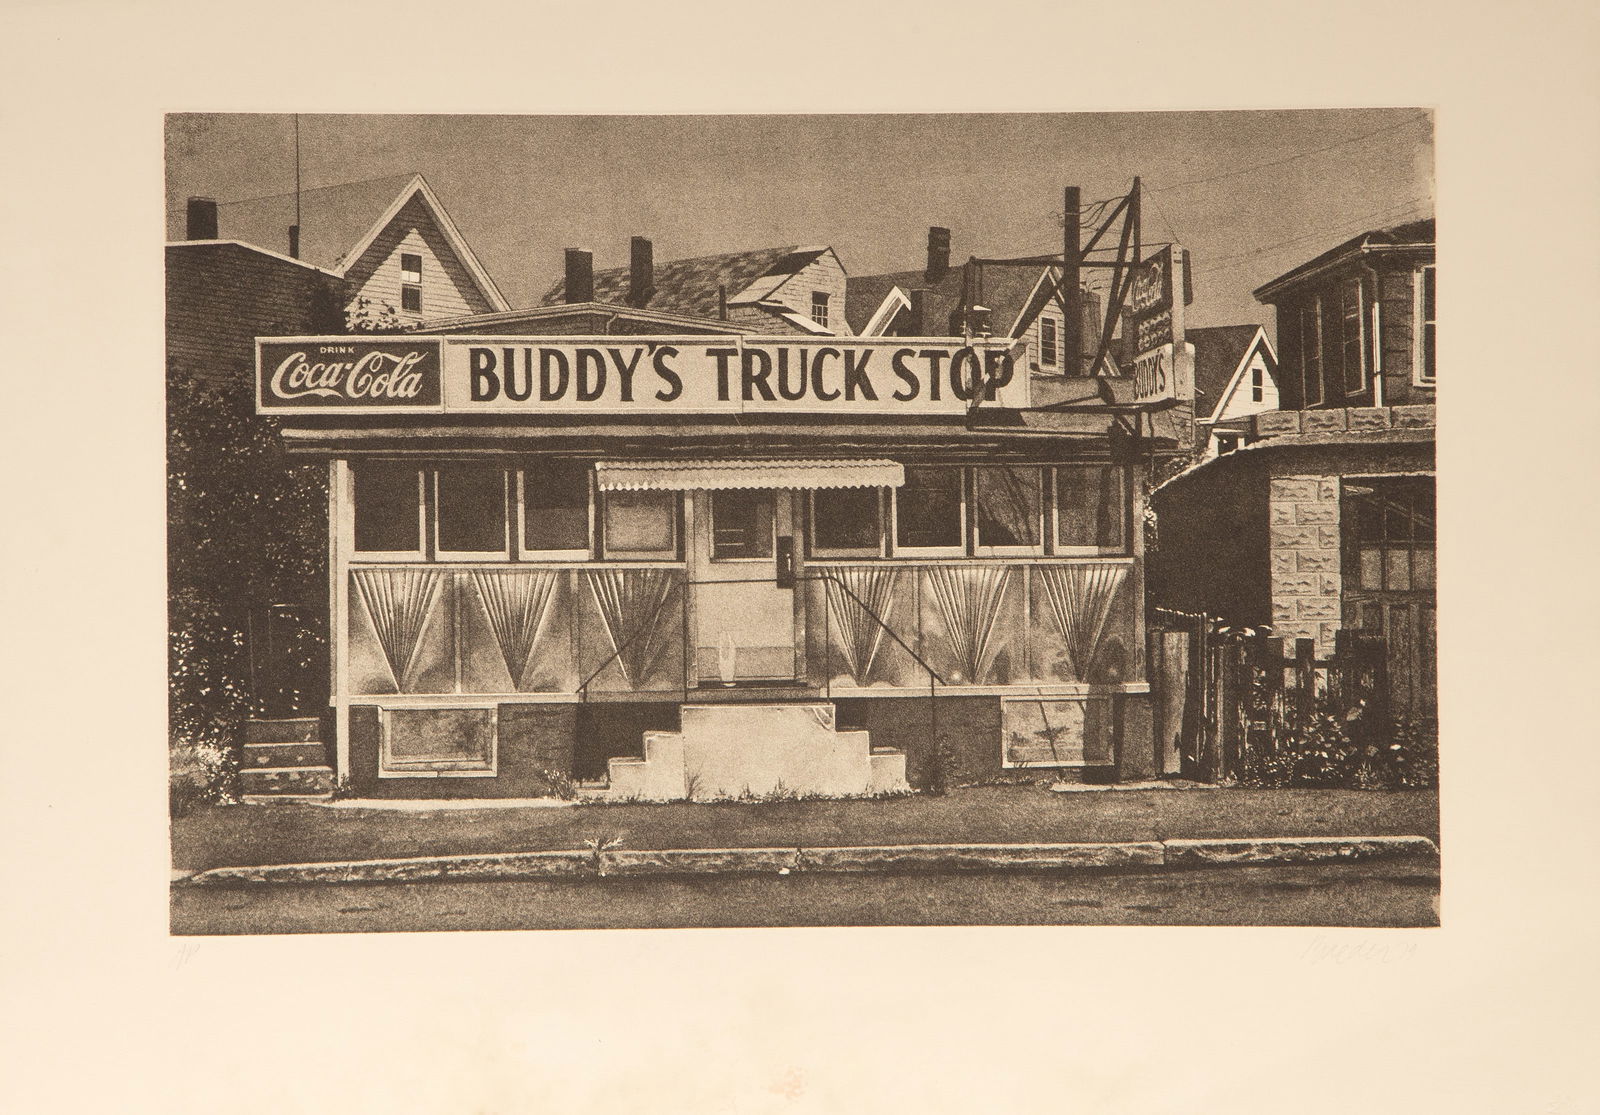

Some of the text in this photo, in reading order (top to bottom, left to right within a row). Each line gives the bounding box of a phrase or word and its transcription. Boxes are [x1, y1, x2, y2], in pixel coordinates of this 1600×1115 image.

[270, 350, 429, 399] Coca-Cola
[320, 346, 355, 355] DRINK
[470, 342, 1014, 402] BUDDY'S TRUCK STOP
[1134, 348, 1166, 401] BUDDY'S
